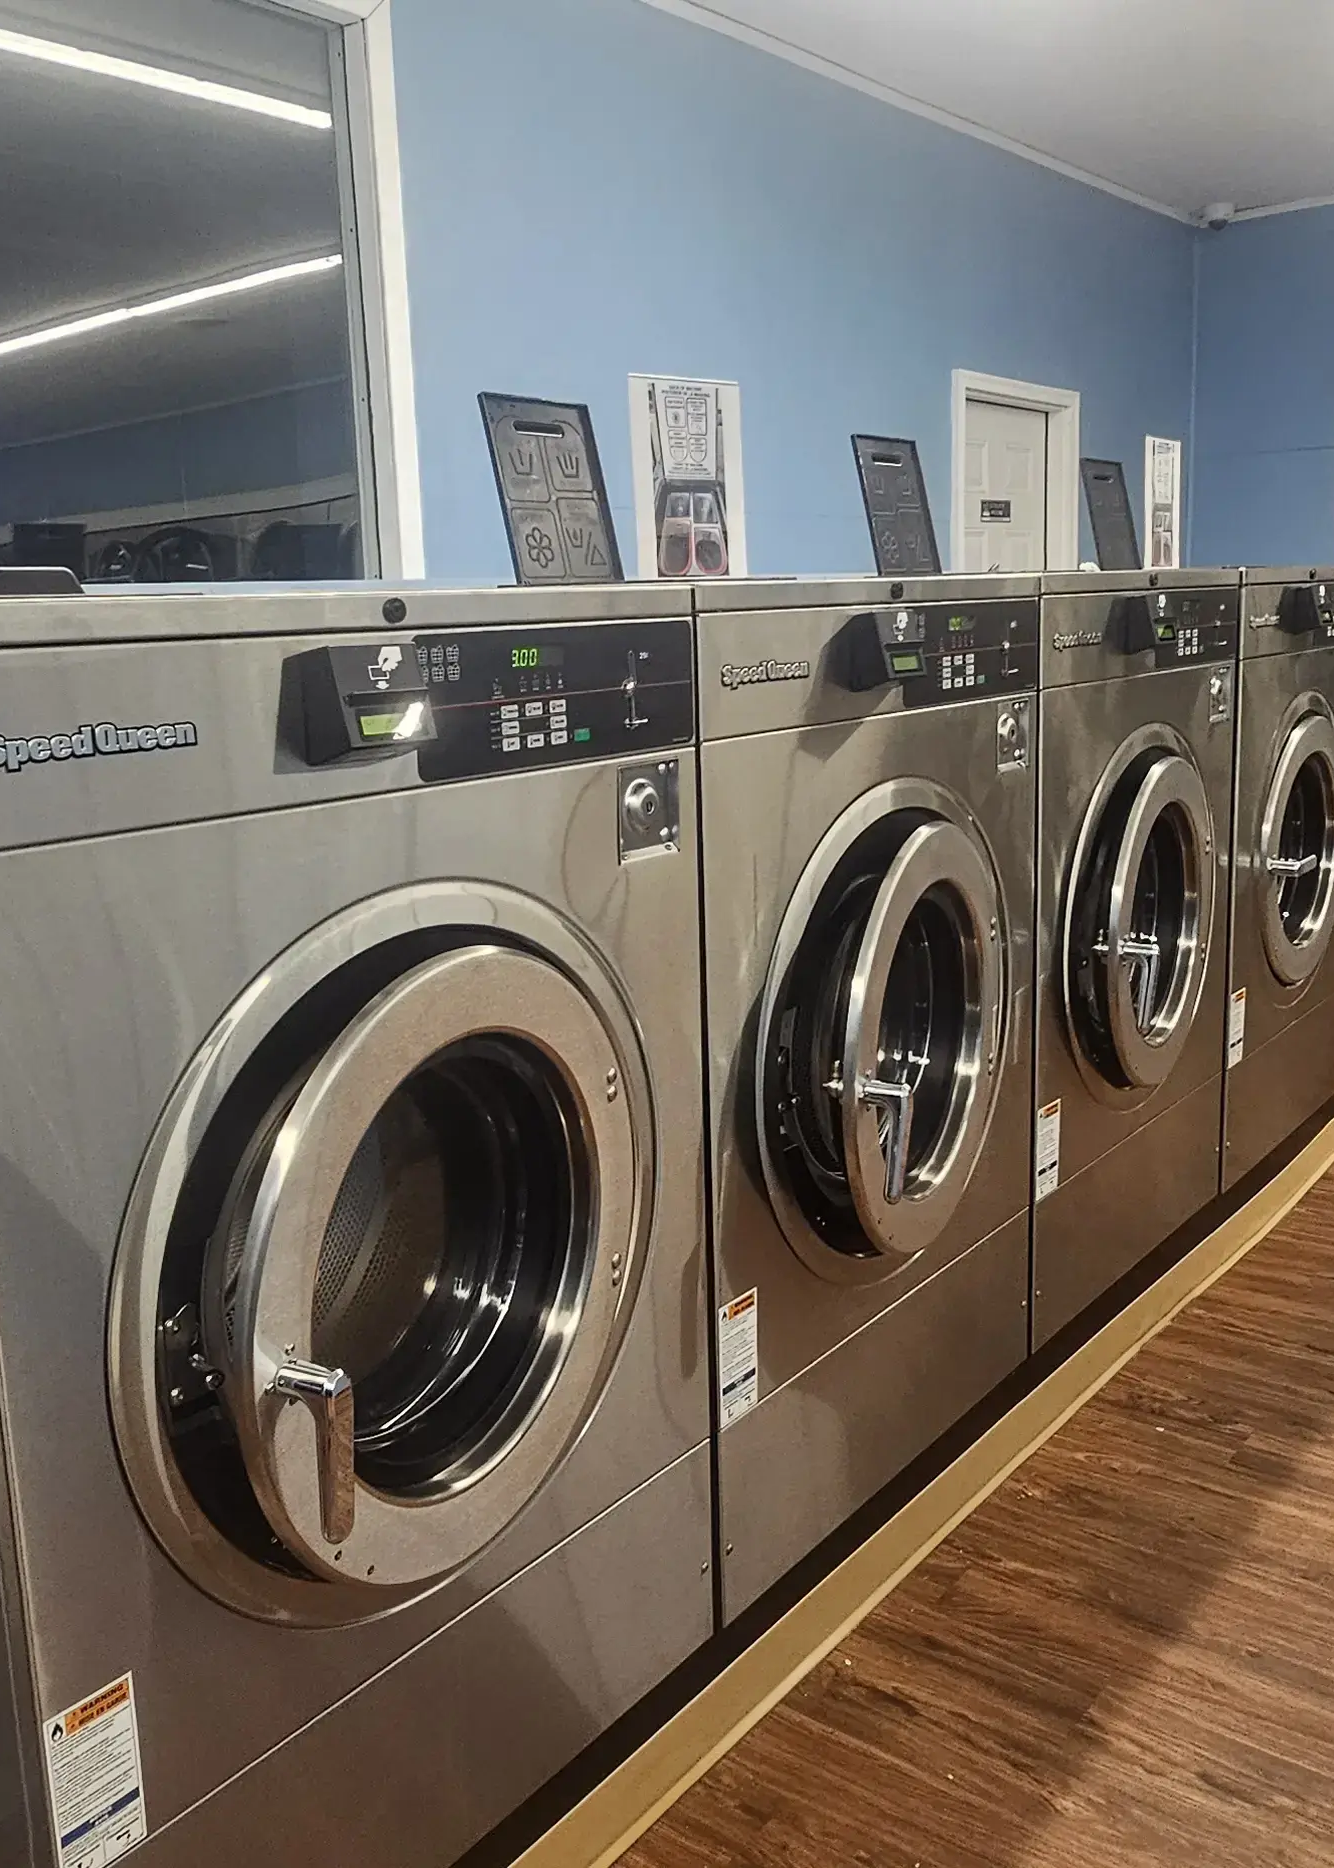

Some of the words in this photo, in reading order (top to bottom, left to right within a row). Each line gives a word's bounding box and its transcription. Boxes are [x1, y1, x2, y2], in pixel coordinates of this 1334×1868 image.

[721, 660, 768, 690] Speed
[767, 659, 810, 682] Queen
[94, 720, 198, 756] Queen
